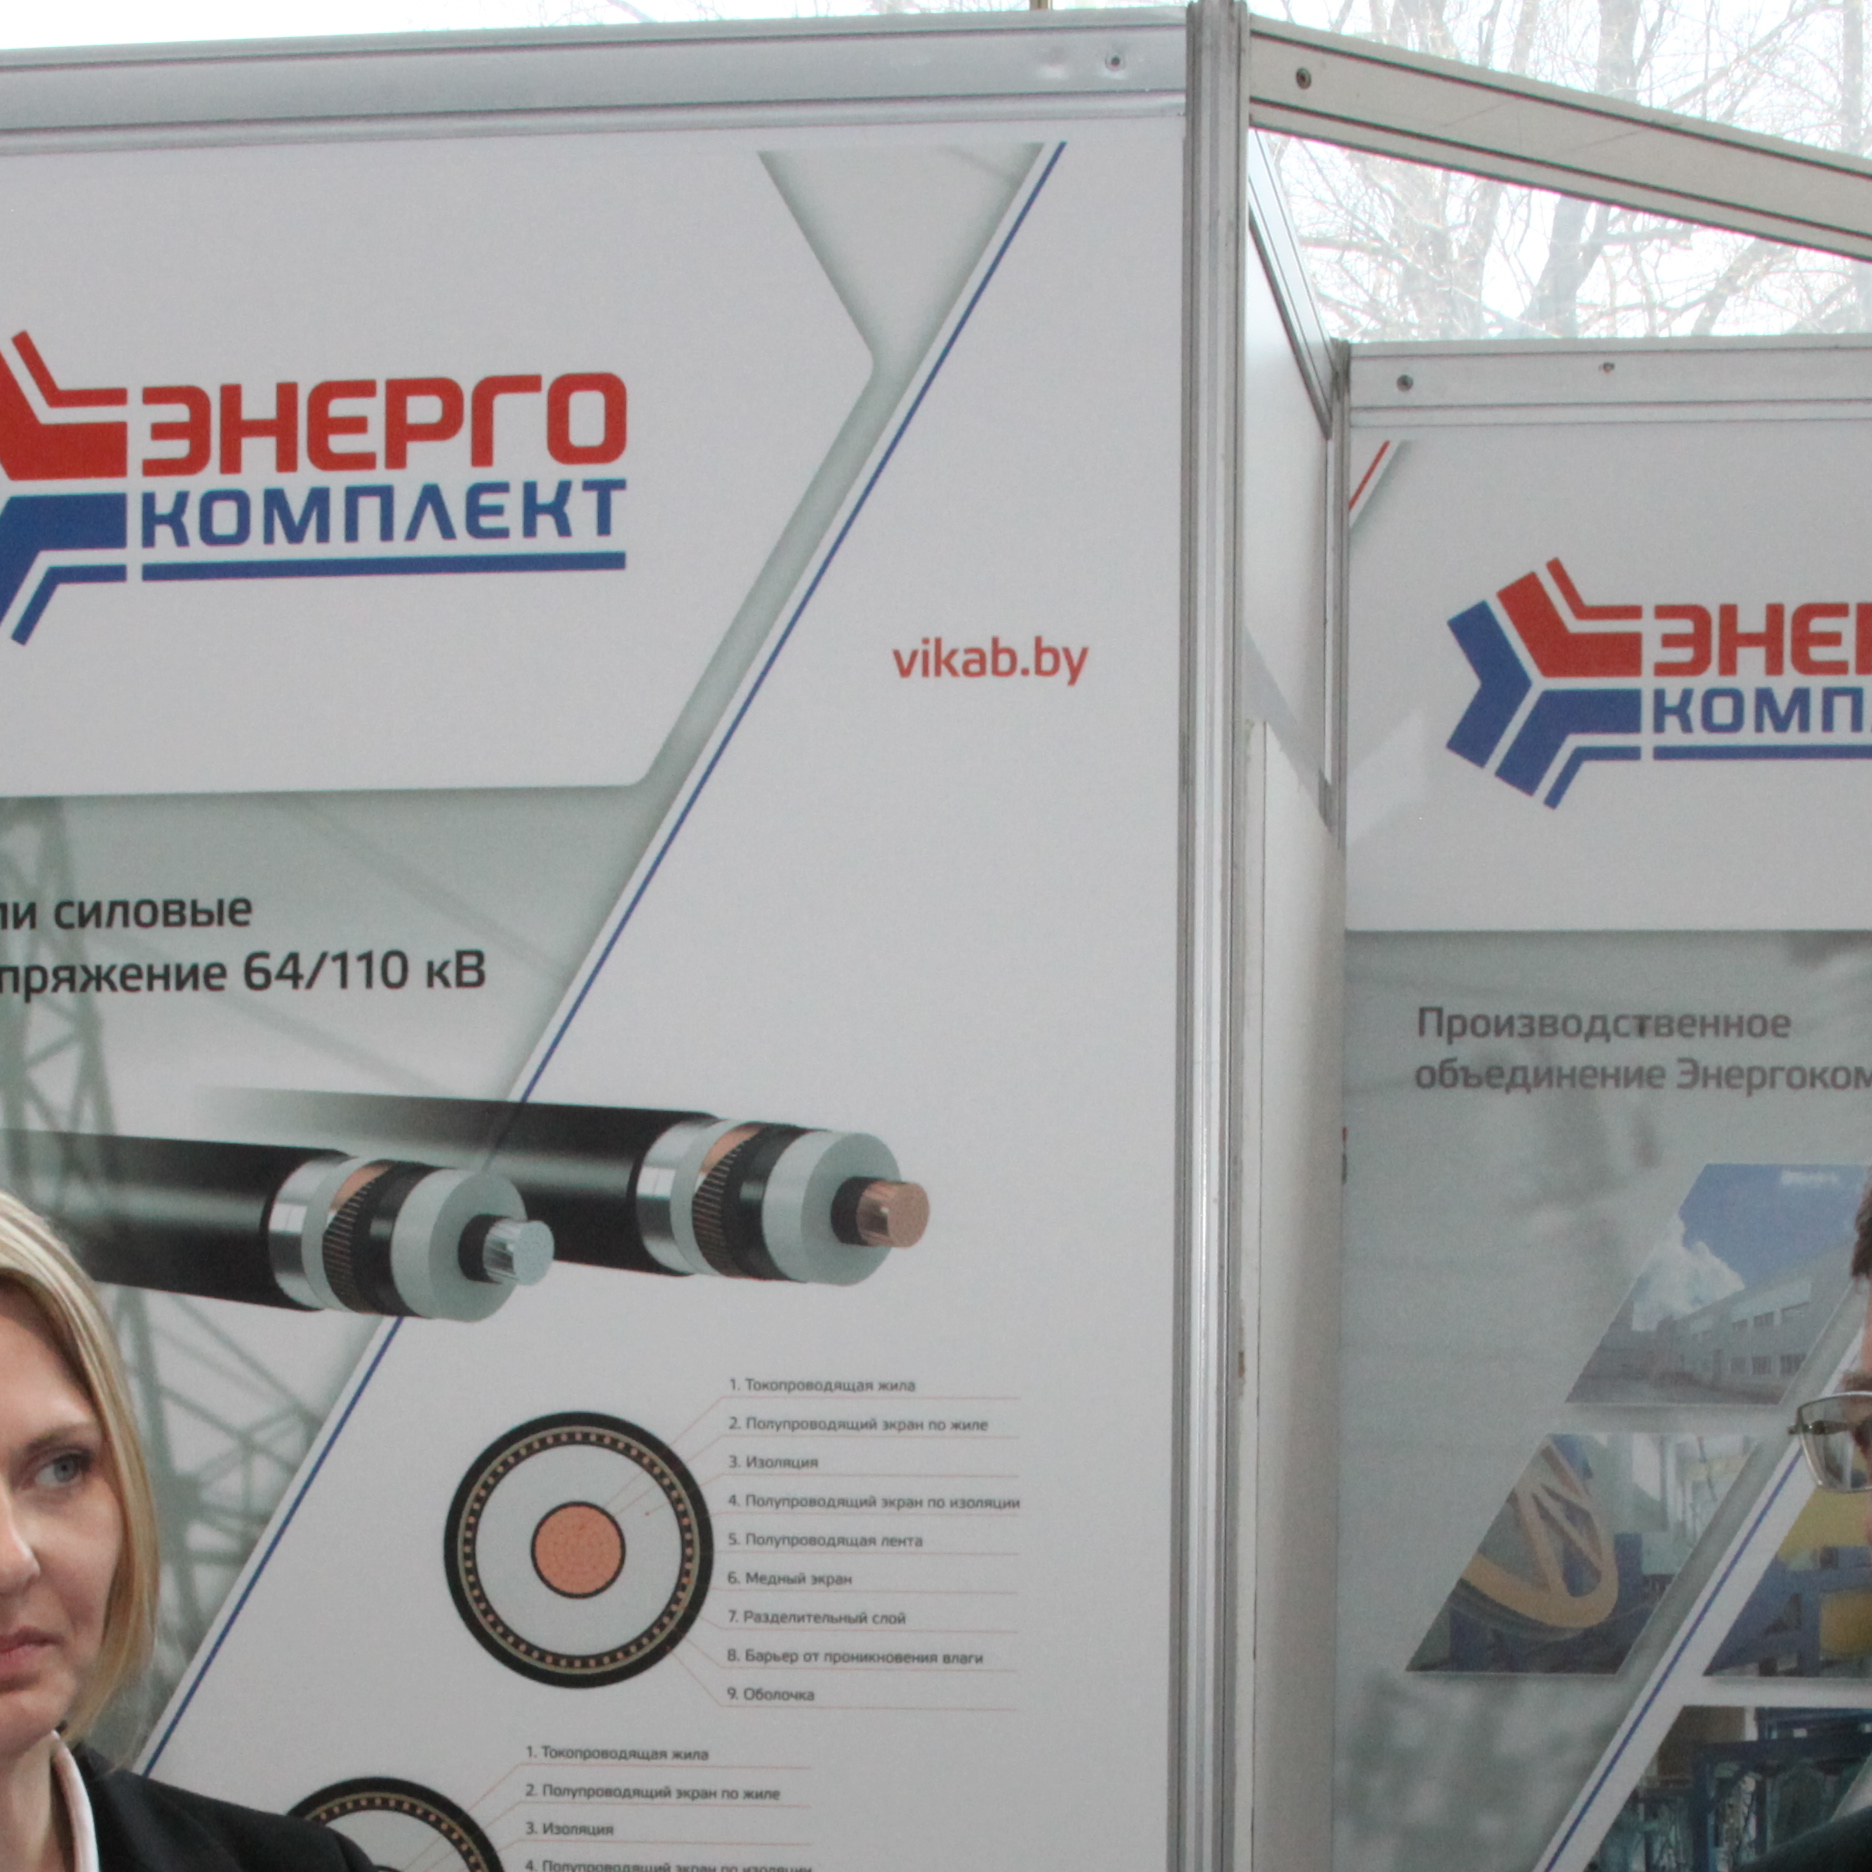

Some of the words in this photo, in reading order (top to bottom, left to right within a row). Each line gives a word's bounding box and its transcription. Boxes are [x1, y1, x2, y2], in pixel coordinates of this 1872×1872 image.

[141, 372, 627, 476] ЭНЕРГО
[141, 480, 627, 547] КОМПЛЕКТ
[892, 635, 1089, 686] vikab.by
[53, 897, 252, 931] силовые
[243, 948, 409, 991] 64/110
[426, 948, 486, 988] кВ
[1418, 1005, 1792, 1046] Производственное
[1413, 1056, 1667, 1094] объединение
[729, 1377, 741, 1391] 1.
[744, 1377, 874, 1394] Токопроводящая
[878, 1380, 917, 1393] жила
[728, 1415, 742, 1430] 2.
[745, 1415, 878, 1433] Полупроводящий
[882, 1420, 924, 1433] экран
[927, 1420, 947, 1432] по
[950, 1420, 989, 1431] жиле
[729, 1454, 741, 1469] 3.
[745, 1455, 819, 1470] Изоляция
[727, 1493, 741, 1507] 4.
[745, 1493, 878, 1510] Полупроводящий
[881, 1497, 924, 1512] экран
[927, 1497, 946, 1509] по
[949, 1497, 1021, 1510] изоляции
[727, 1531, 741, 1546] 5.
[745, 1532, 877, 1549] Полупроводящая
[880, 1536, 924, 1548] лента
[727, 1570, 741, 1585] 6.
[745, 1571, 807, 1586] Медный
[810, 1574, 853, 1588] экран
[728, 1608, 739, 1623] 7.
[743, 1609, 869, 1625] Разделительный
[871, 1611, 907, 1625] слой
[727, 1648, 741, 1663] 8.
[744, 1647, 800, 1665] Барьер
[802, 1651, 820, 1663] от
[823, 1652, 939, 1665] проникновения
[942, 1653, 984, 1665] влаги
[726, 1686, 739, 1700] 9.
[743, 1686, 816, 1702] Оболочка
[526, 1745, 537, 1758] 1.
[540, 1744, 668, 1762] Токопроводящая
[672, 1750, 710, 1761] жила
[525, 1783, 537, 1797] 2.
[542, 1783, 673, 1801] Полупроводящий
[675, 1788, 718, 1802] экран
[720, 1789, 739, 1800] по
[742, 1790, 781, 1801] жиле
[525, 1820, 538, 1836] 3.
[542, 1821, 615, 1837] Изоляция
[524, 1859, 538, 1872] 4.
